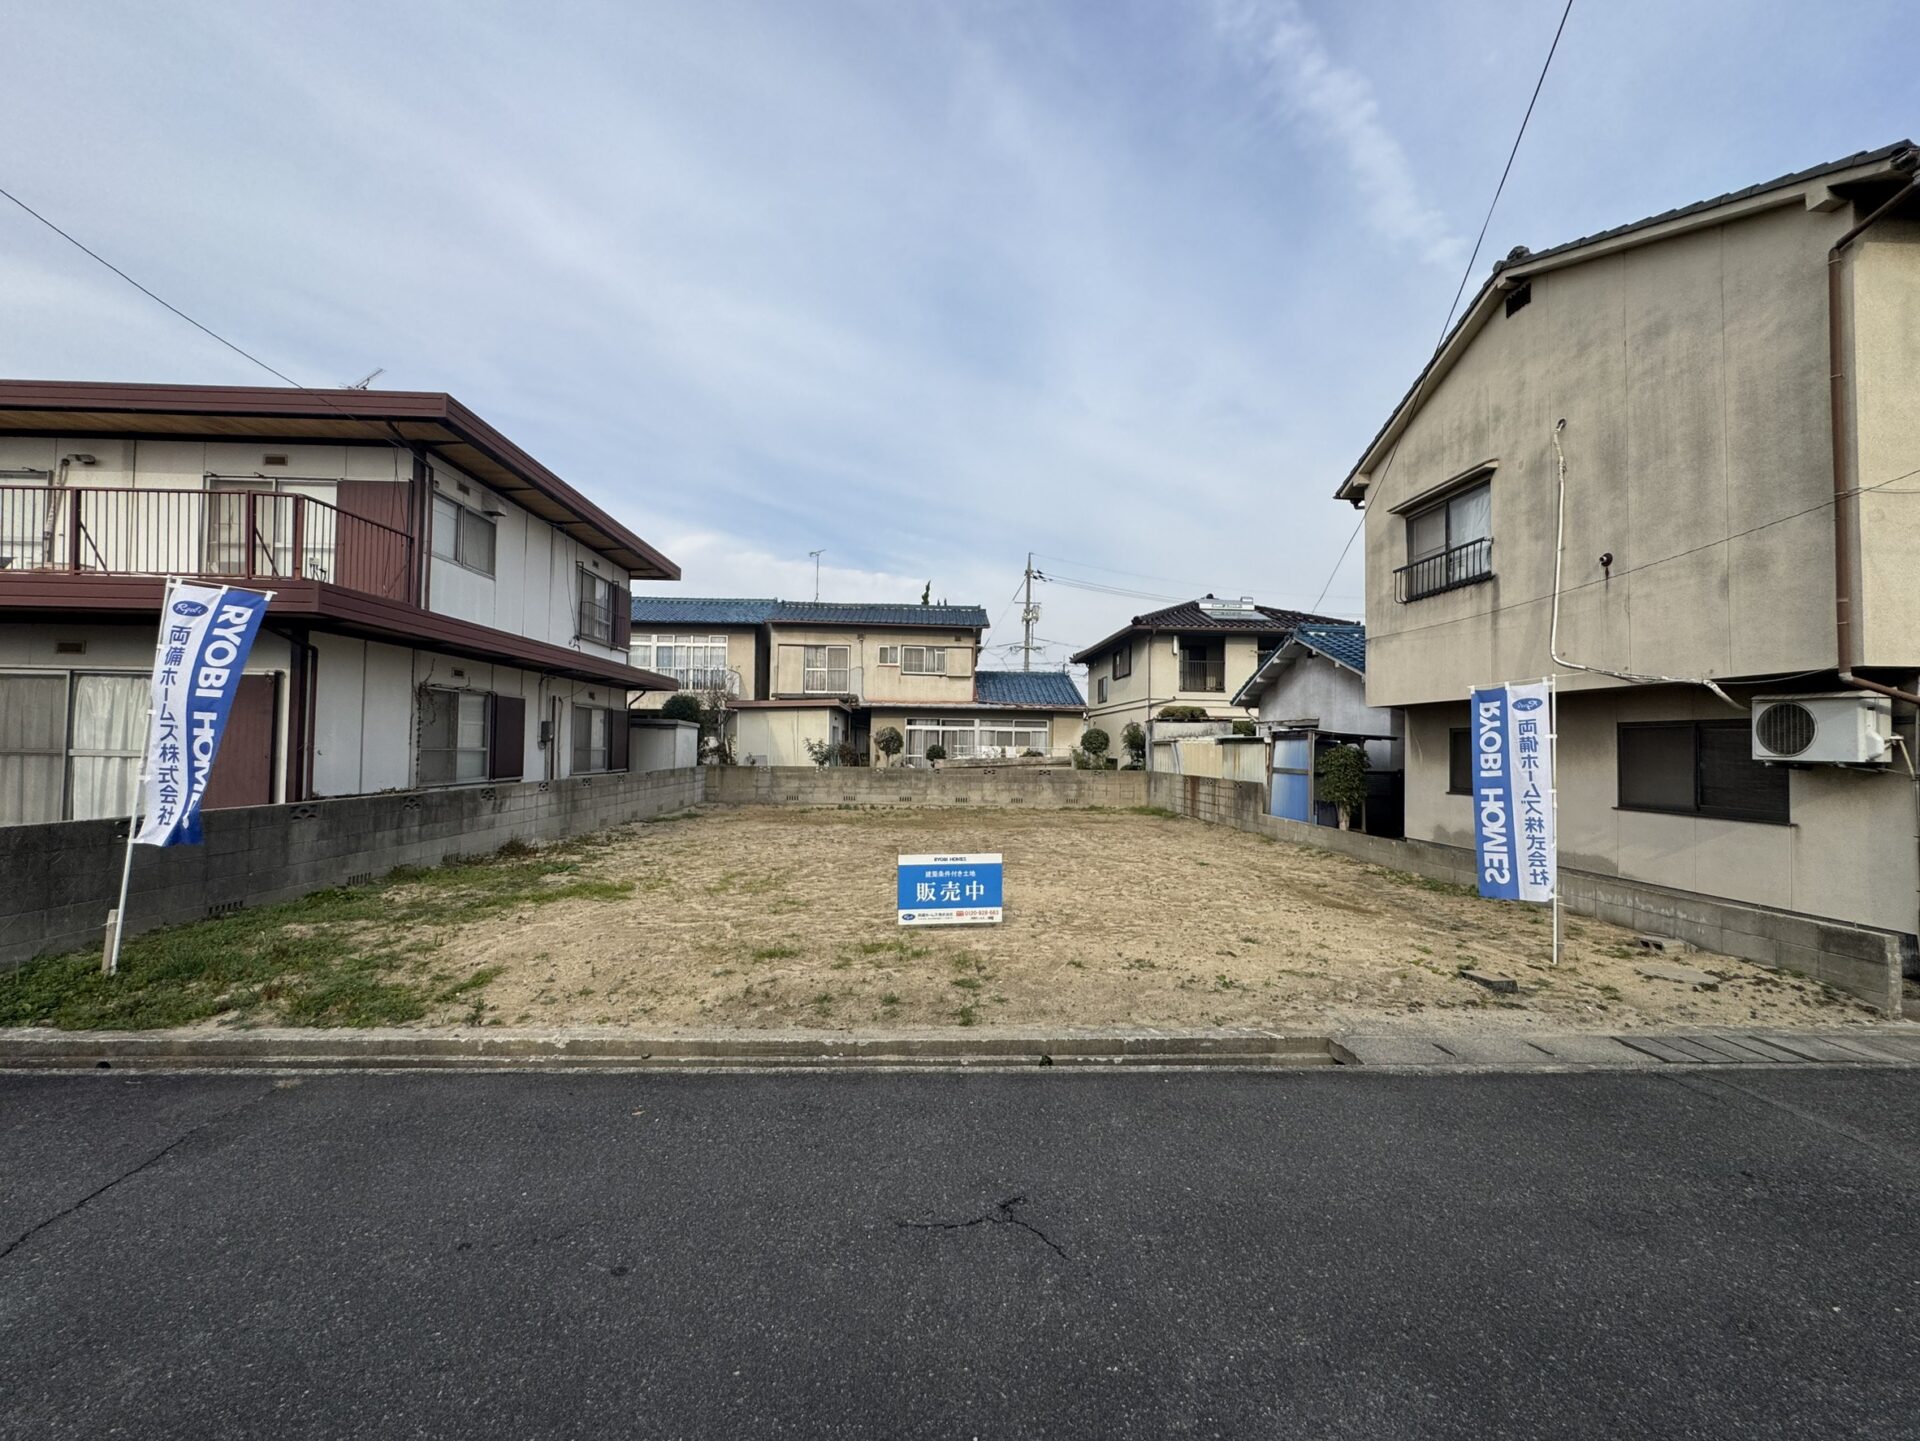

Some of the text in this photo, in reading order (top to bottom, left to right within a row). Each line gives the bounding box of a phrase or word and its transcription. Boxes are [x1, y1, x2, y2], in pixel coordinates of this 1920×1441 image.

[157, 625, 192, 826] 両備ホームズ株式会社
[182, 604, 254, 829] RYOBI HOM
[916, 880, 984, 902] 販売中
